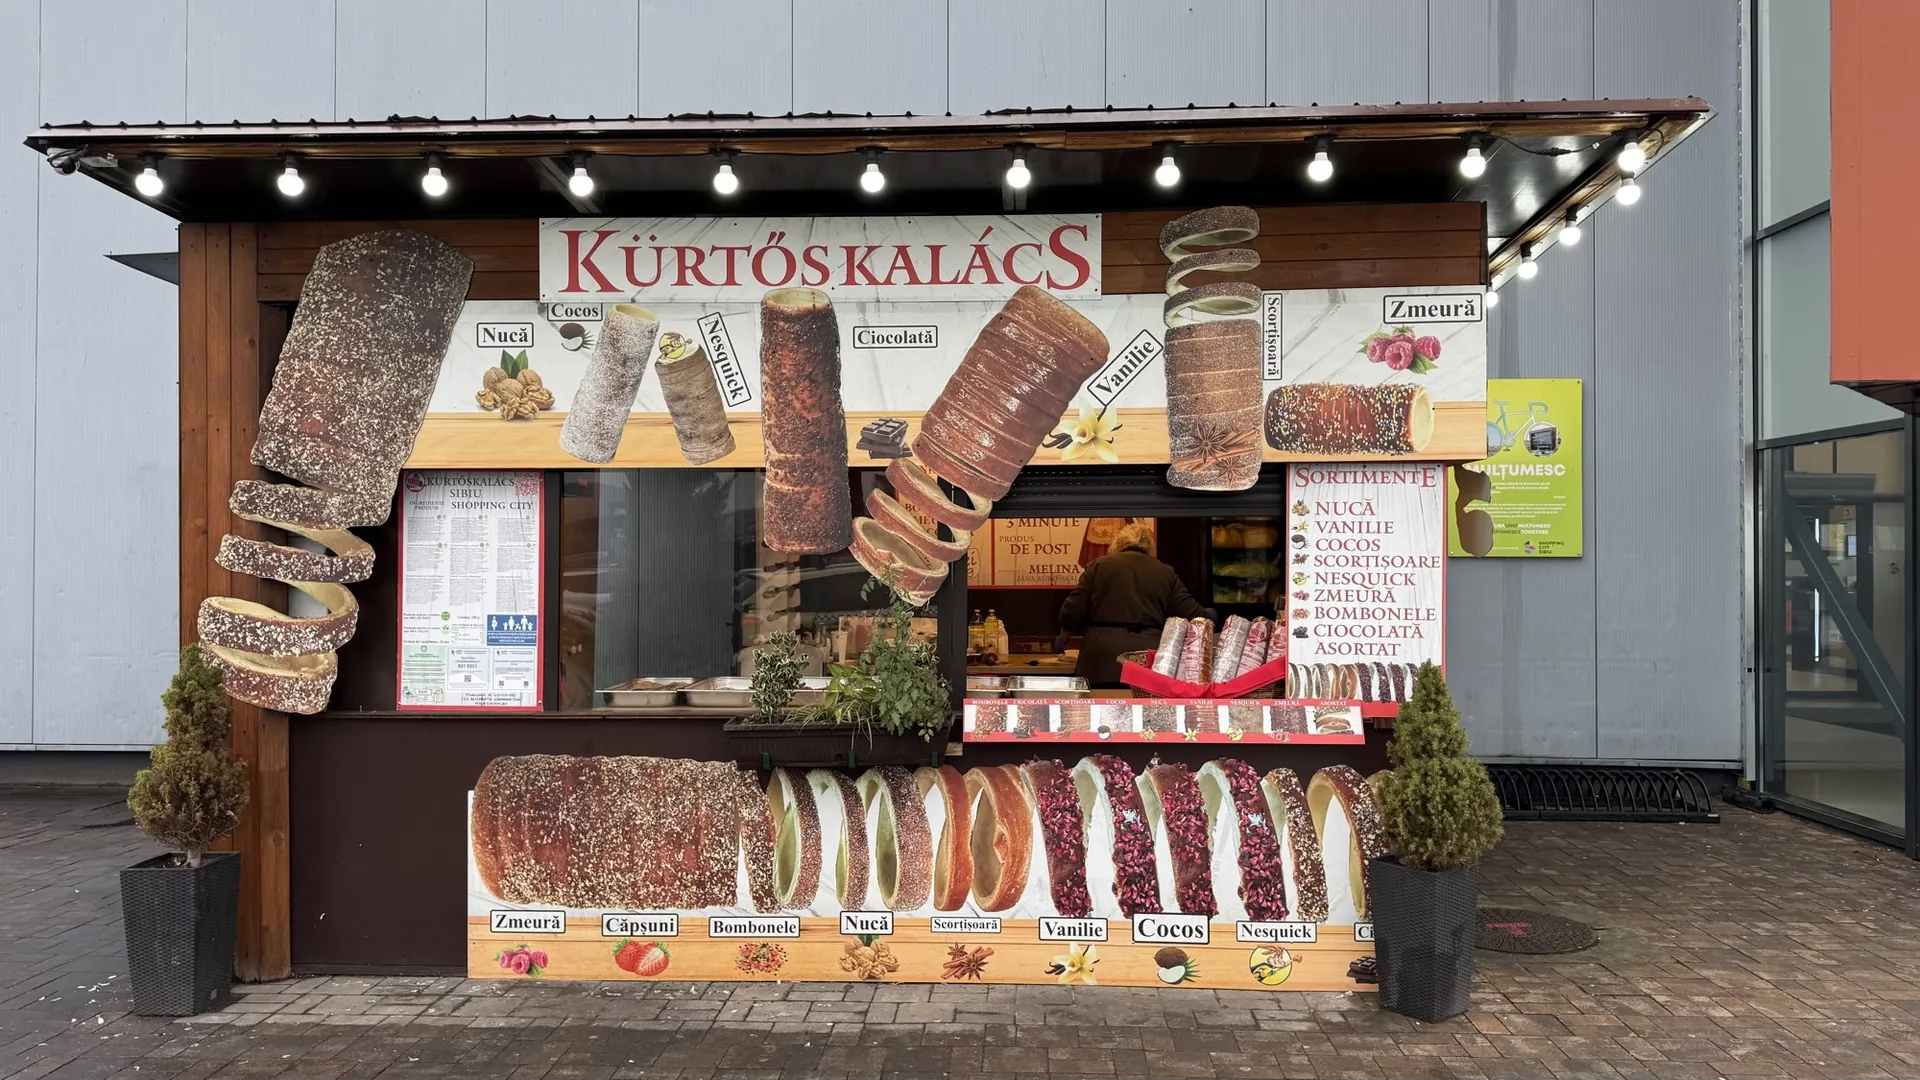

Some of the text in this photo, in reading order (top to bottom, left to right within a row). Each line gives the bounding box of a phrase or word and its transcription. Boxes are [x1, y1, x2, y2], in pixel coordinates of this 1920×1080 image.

[558, 224, 1091, 292] KÜRTŐSKALÁCS
[551, 303, 599, 318] Cocos
[1390, 299, 1476, 319] Zmeură
[482, 327, 529, 343] Nucă
[857, 329, 933, 345] Ciocolată
[1265, 297, 1280, 376] Scorțișoară
[704, 317, 744, 400] Nesquick
[1095, 339, 1156, 395] Vanilie
[1295, 467, 1437, 488] SORTIMENTE
[449, 489, 482, 498] SIBIU
[451, 501, 533, 510] SHOPPING CITY
[1315, 498, 1376, 516] NUCĂ
[1017, 518, 1080, 528] MINUTE
[1315, 521, 1394, 534] VANILIE
[1010, 544, 1071, 555] DE POST
[1315, 538, 1380, 551] COCOS
[1029, 564, 1080, 574] MELINA
[1314, 555, 1440, 570] SCORȚIȘOARE
[1314, 572, 1416, 589] NESQUICK
[1314, 586, 1397, 603] ZMEURĂ
[1314, 607, 1436, 621] BOMBONELE
[1314, 623, 1424, 639] CIOCOLATĂ
[1314, 642, 1401, 656] ASORTAT
[495, 913, 561, 929] Zmeură
[605, 917, 674, 935] Căpșuni
[714, 920, 796, 934] Bombonele
[845, 915, 888, 931] Nucă
[933, 918, 998, 932] Scorțișoară
[1044, 921, 1103, 937] Vanilie
[1138, 918, 1204, 939] Cocos
[1241, 924, 1312, 941] Nesquick
